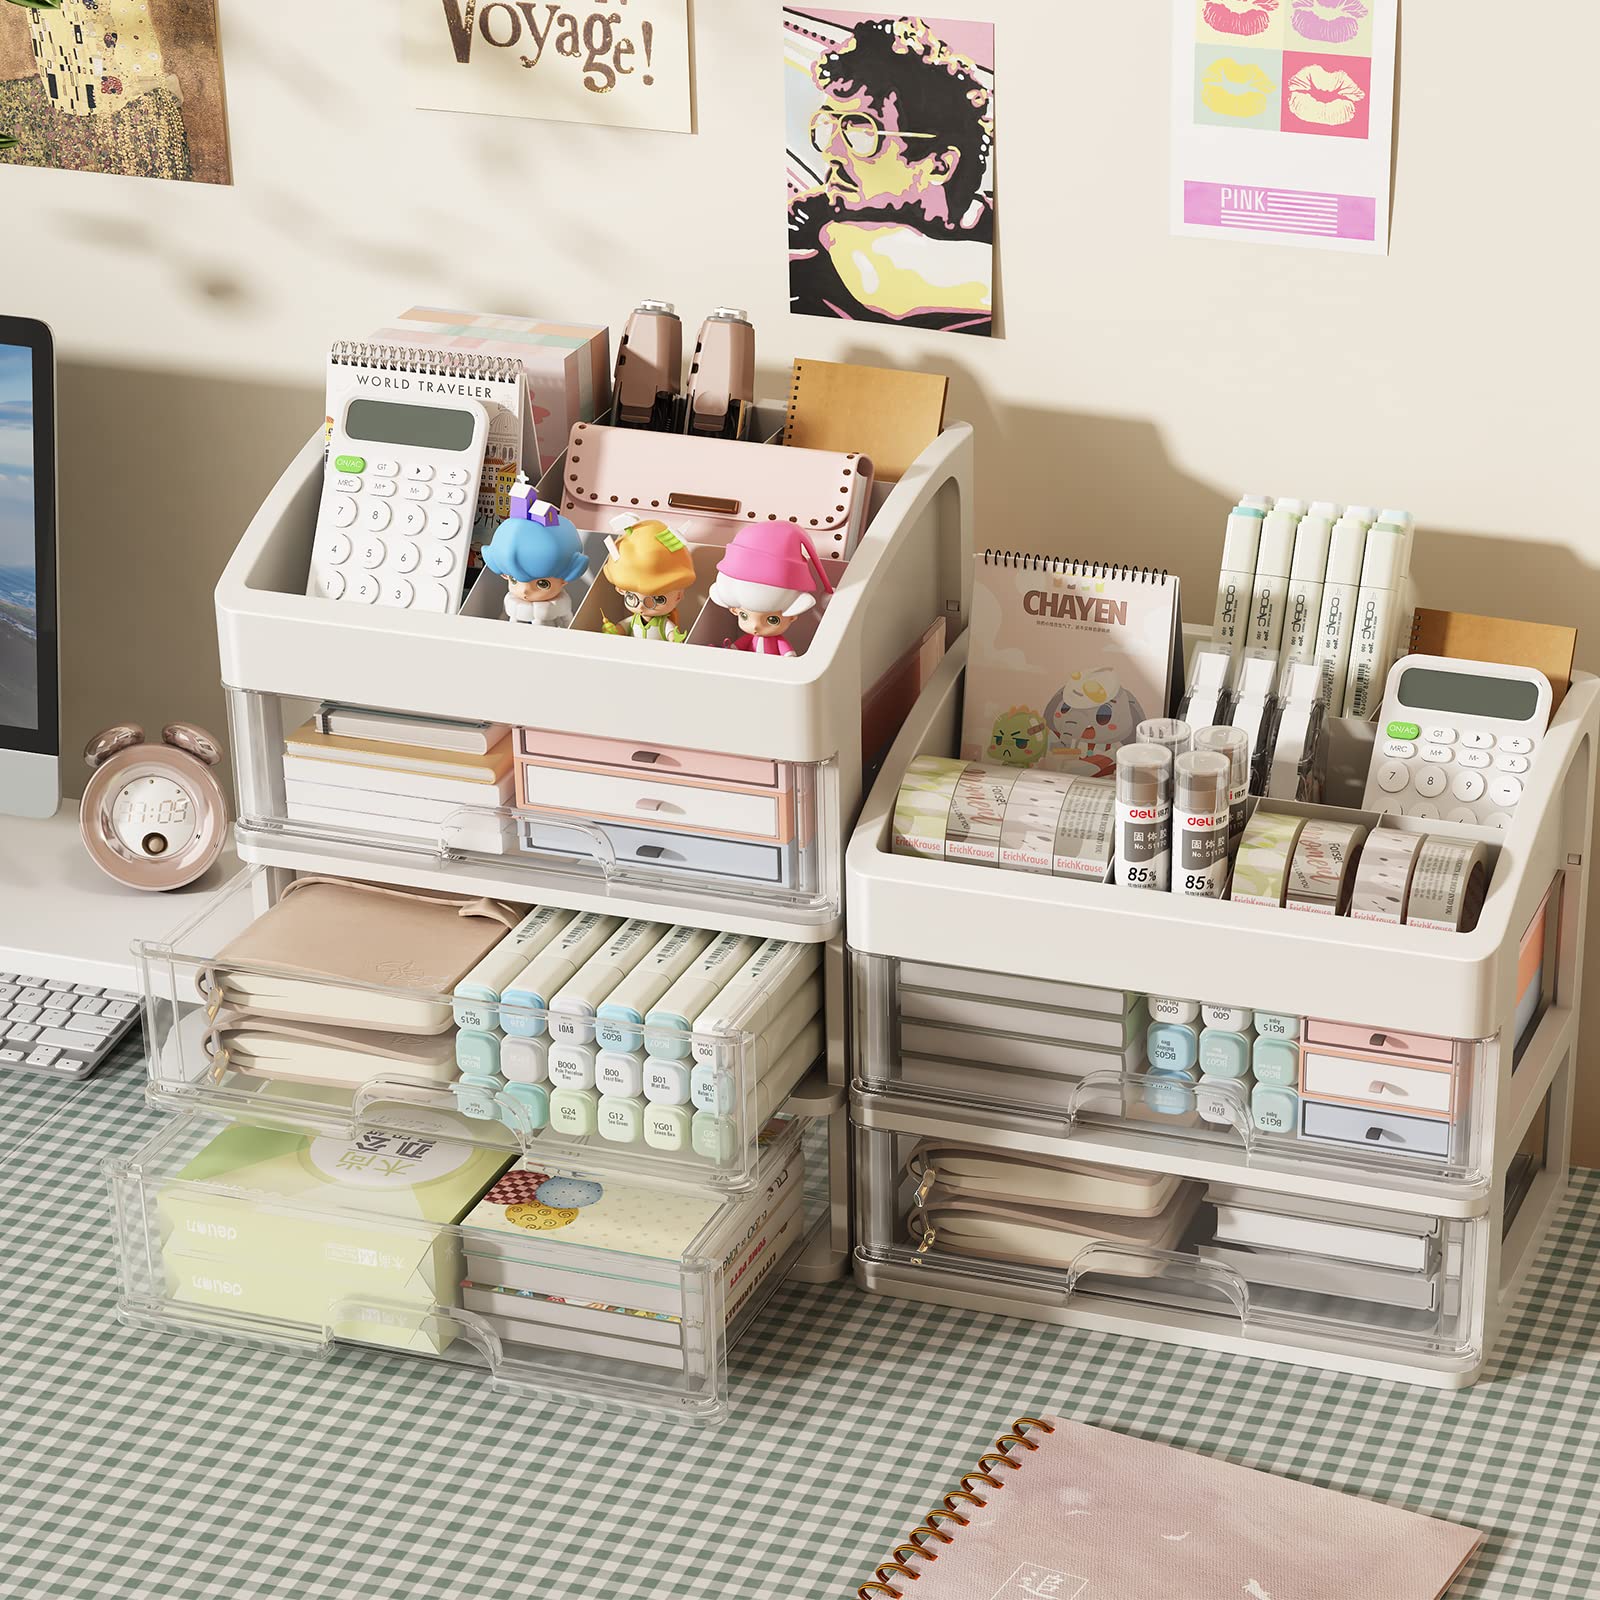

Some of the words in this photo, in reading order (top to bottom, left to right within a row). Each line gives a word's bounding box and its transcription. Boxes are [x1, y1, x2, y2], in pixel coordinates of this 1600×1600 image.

[443, 0, 654, 93] Voyage!
[1221, 187, 1266, 212] PINK
[357, 374, 410, 390] WORLD
[418, 381, 492, 398] TRAVELER
[336, 458, 361, 468] ON/AC
[337, 506, 343, 516] 7
[372, 510, 379, 520] 8
[407, 514, 414, 524] 9
[331, 545, 337, 555] 4
[366, 549, 372, 558] 5
[400, 553, 407, 562] 6
[360, 585, 367, 595] 2
[395, 590, 401, 600] 3
[1023, 590, 1127, 626] CHAYEN
[1390, 724, 1416, 735] ON/AC
[1390, 745, 1407, 753] MRC
[1389, 771, 1396, 780] 7
[1427, 776, 1434, 785] 8
[1465, 781, 1472, 790] 9
[1129, 809, 1156, 819] deli
[1187, 817, 1214, 827] deli
[895, 834, 941, 851] ErichKrause
[949, 844, 995, 859] ErichKrause
[1003, 851, 1049, 866] ErichKrause
[1057, 858, 1103, 873] ErichKrause
[1128, 868, 1156, 882] 85%
[1185, 875, 1214, 890] 85%
[1157, 1005, 1179, 1015] G000
[461, 1016, 481, 1025] BG15
[1213, 1012, 1230, 1020] G00
[558, 1024, 574, 1034] BV01
[1263, 1024, 1285, 1033] BG15
[602, 1032, 622, 1042] BG05
[1155, 1051, 1176, 1060] BG05
[557, 1061, 576, 1070] B000
[604, 1068, 619, 1077] B00
[652, 1075, 666, 1084] B01
[561, 1107, 576, 1115] G24
[608, 1112, 624, 1120] G12
[653, 1122, 673, 1131] YG01
[1260, 1117, 1282, 1127] BG15
[336, 1151, 416, 1177] 木尚
[207, 1223, 237, 1241] deli
[212, 1279, 243, 1296] deli
